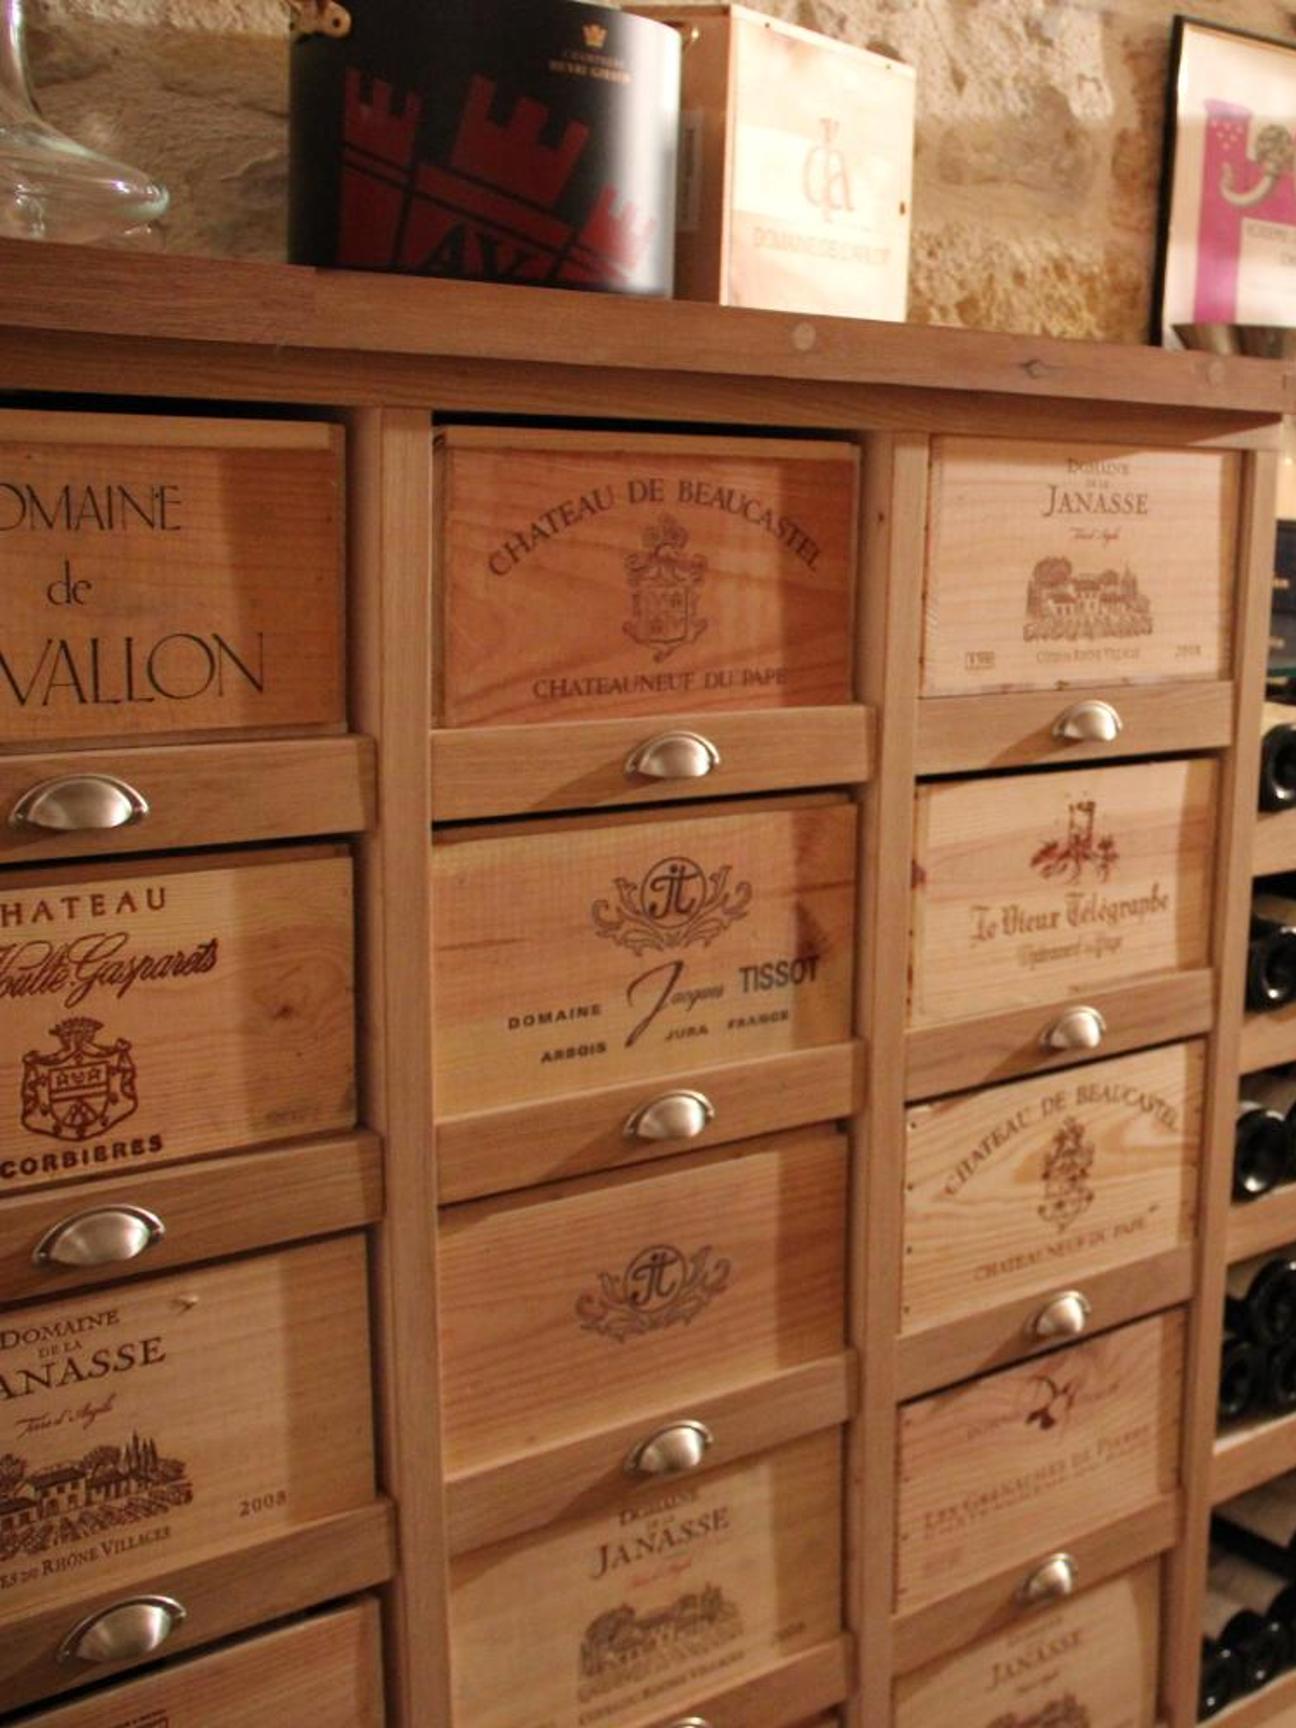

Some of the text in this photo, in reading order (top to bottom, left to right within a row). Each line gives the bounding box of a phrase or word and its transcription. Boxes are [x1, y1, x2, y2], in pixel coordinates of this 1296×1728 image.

[0, 483, 182, 531] OMAINE
[1042, 484, 1149, 518] JANASSE
[488, 478, 823, 578] CHATEAU DE BEAUCASTEL
[47, 559, 92, 606] de
[533, 667, 788, 700] CHATEAUNEUF DU PAPE
[2, 887, 166, 927] HATEAU
[508, 1004, 603, 1031] DOMAINE
[739, 955, 820, 993] TISSOT
[540, 1009, 790, 1064] ARBOIS JURA FRANCE
[1041, 1090, 1067, 1118] DE
[1, 1134, 164, 1180] CORBIERES
[1, 1309, 120, 1350] DOMAINE
[0, 1336, 167, 1400] ANASSE
[588, 1507, 731, 1581] JANASSE
